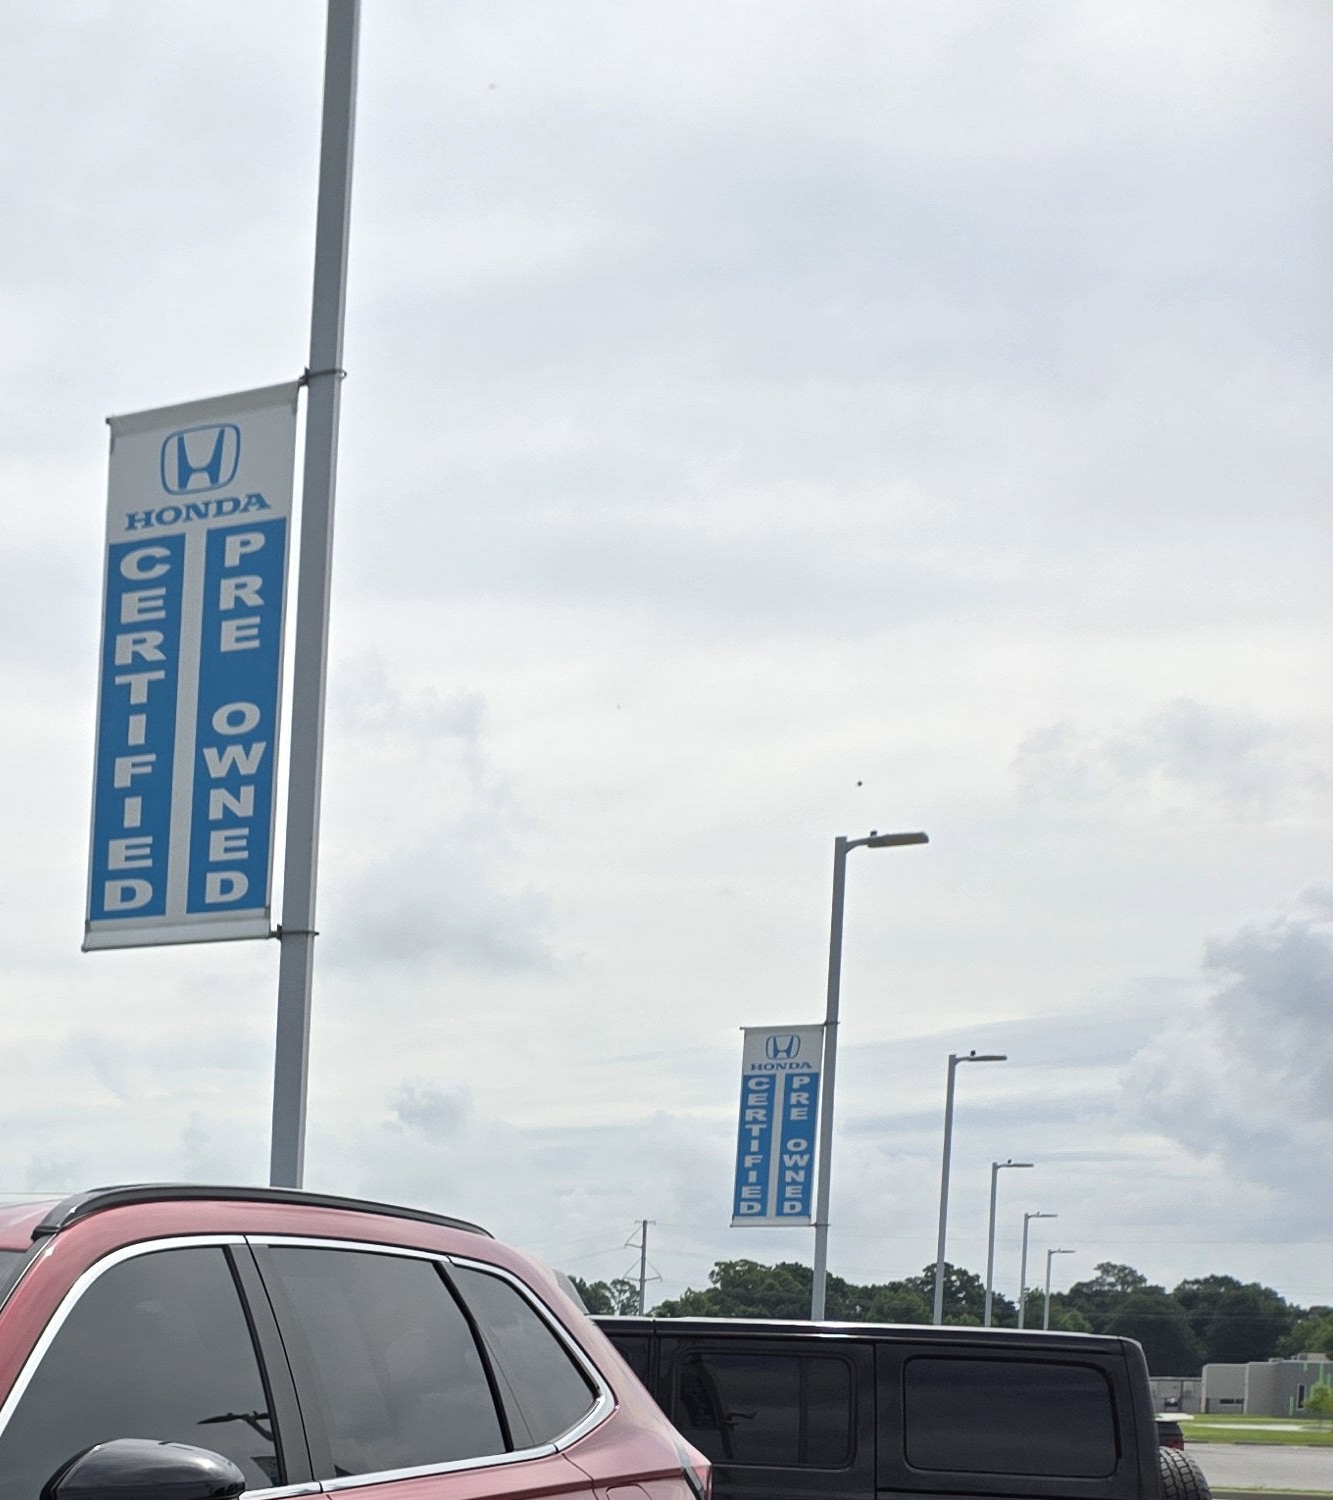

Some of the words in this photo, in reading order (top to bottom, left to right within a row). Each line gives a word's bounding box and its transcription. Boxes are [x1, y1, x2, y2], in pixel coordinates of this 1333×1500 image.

[123, 491, 271, 531] HONDA
[219, 530, 266, 653] PRE
[102, 545, 172, 913] CERTIFIED
[203, 702, 266, 905] OWNED
[750, 1061, 813, 1071] HONDA
[789, 1075, 810, 1121] PRE
[739, 1076, 770, 1214] CERTIFIED
[783, 1138, 810, 1214] OWNED
